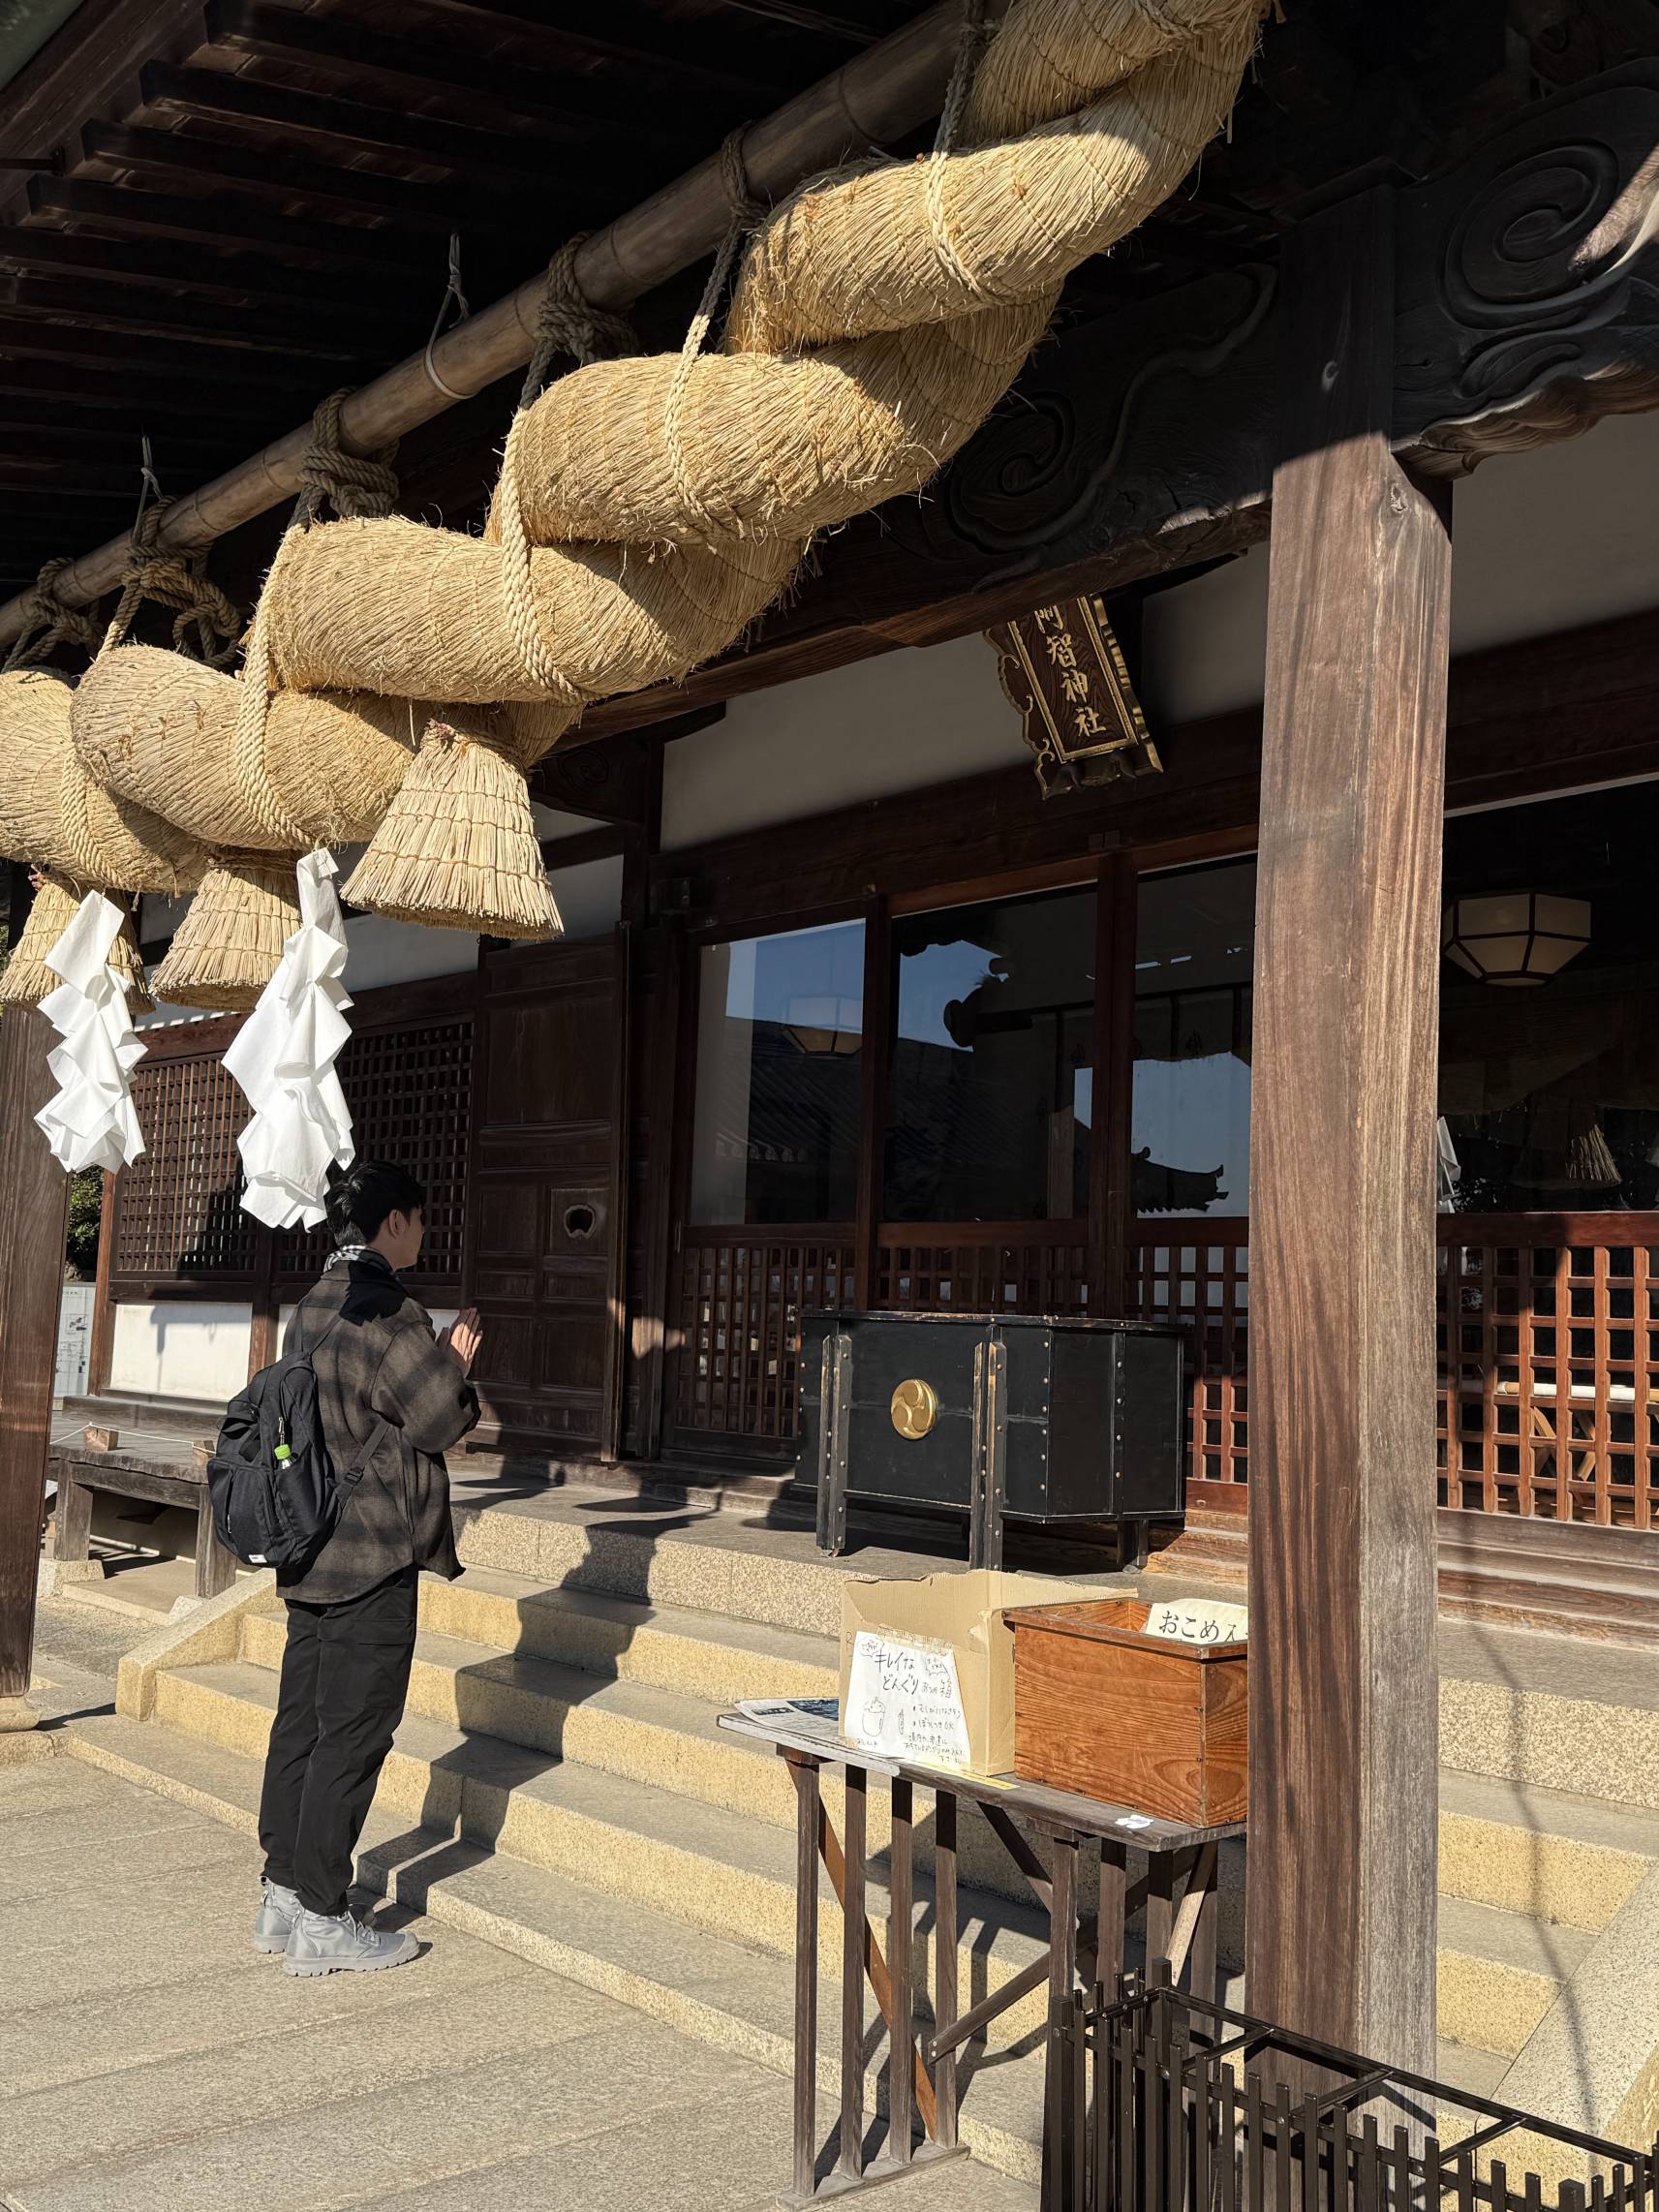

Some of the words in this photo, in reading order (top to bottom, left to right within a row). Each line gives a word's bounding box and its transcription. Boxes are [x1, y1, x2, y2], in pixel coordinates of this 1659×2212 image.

[1158, 1611, 1248, 1643] おこめ入
[875, 1651, 915, 1674] キレイな
[882, 1674, 919, 1696] どんぐり
